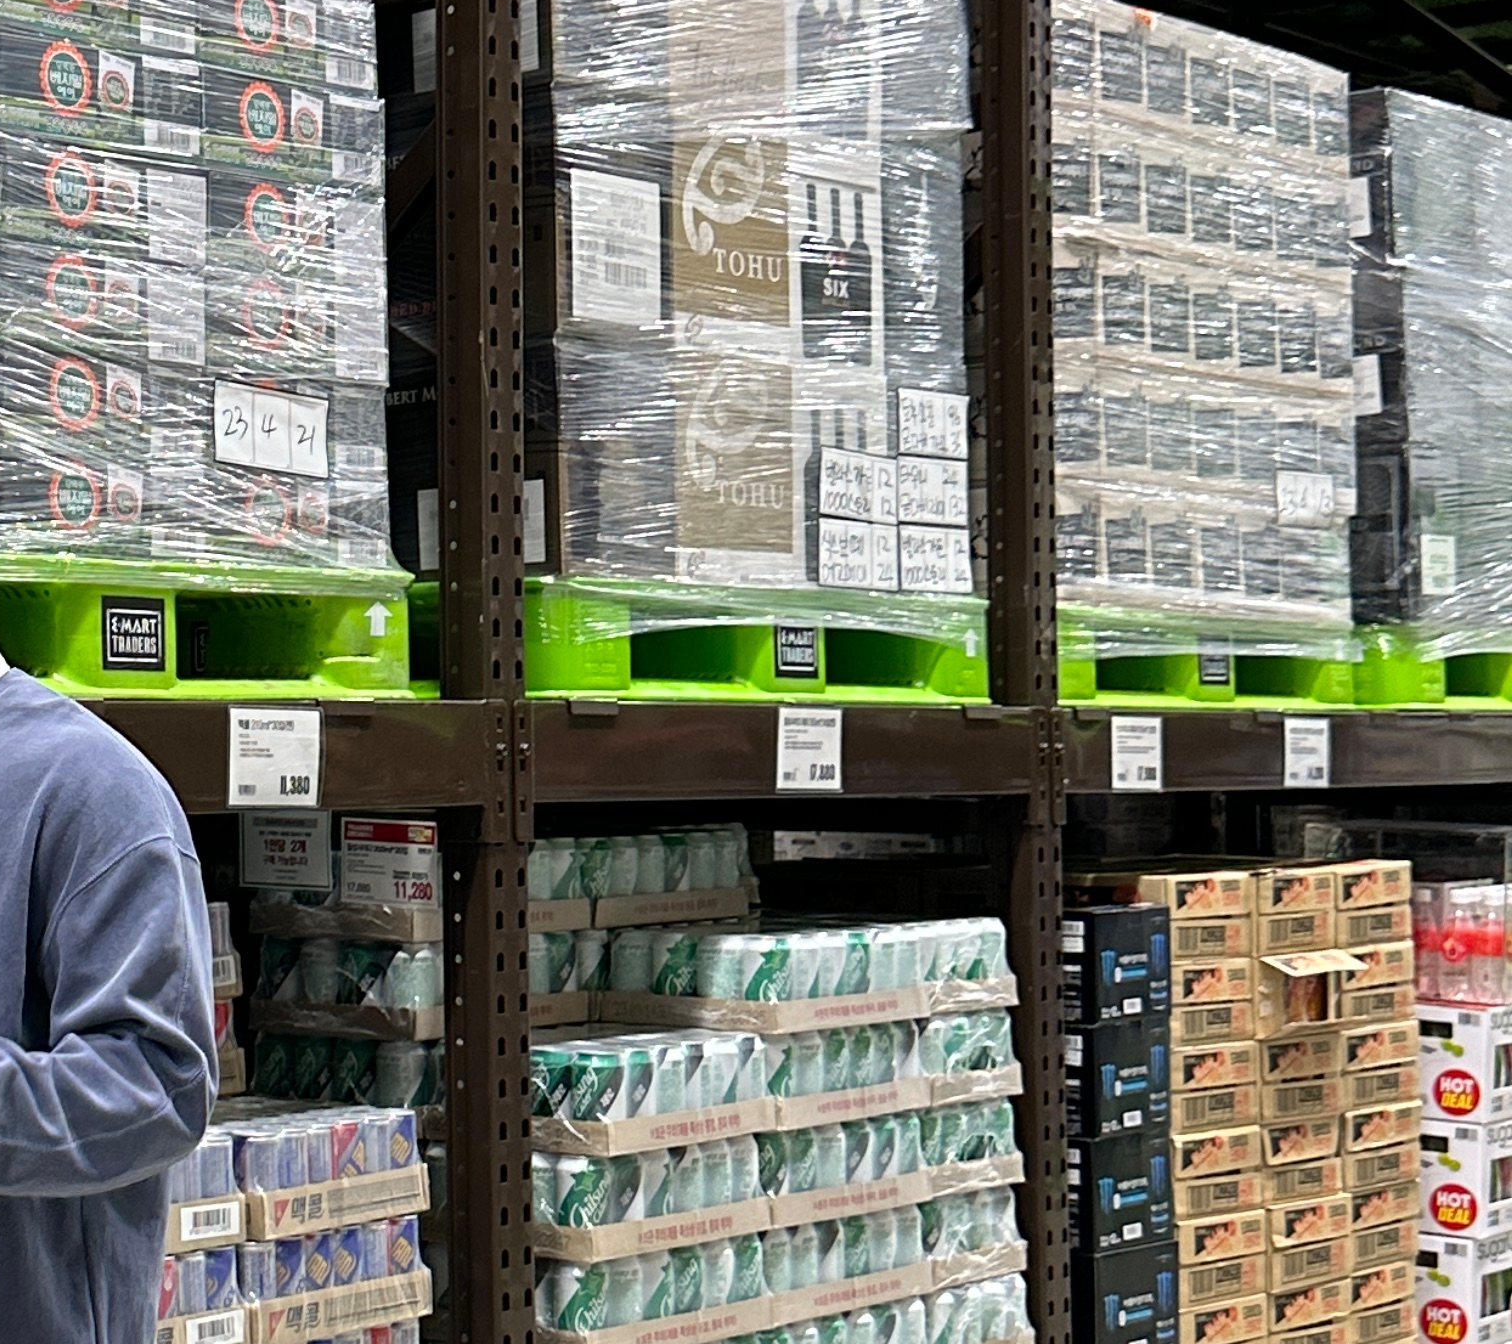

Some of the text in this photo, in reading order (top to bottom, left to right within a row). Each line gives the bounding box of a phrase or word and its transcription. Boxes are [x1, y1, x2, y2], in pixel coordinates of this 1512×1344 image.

[713, 248, 783, 283] TOHU
[823, 277, 850, 300] SIX
[221, 406, 316, 456] 23 4 21
[714, 481, 786, 510] TOHU
[111, 635, 157, 654] TRADERS
[1440, 1077, 1474, 1094] HOT
[1440, 1092, 1474, 1110] DEAL
[291, 1192, 325, 1224] 맥콜
[1436, 1191, 1471, 1209] HOT
[1437, 1207, 1471, 1225] DEAL
[286, 1301, 320, 1333] 맥콜
[1426, 1306, 1462, 1324] HOT
[1427, 1321, 1461, 1340] DEAL
